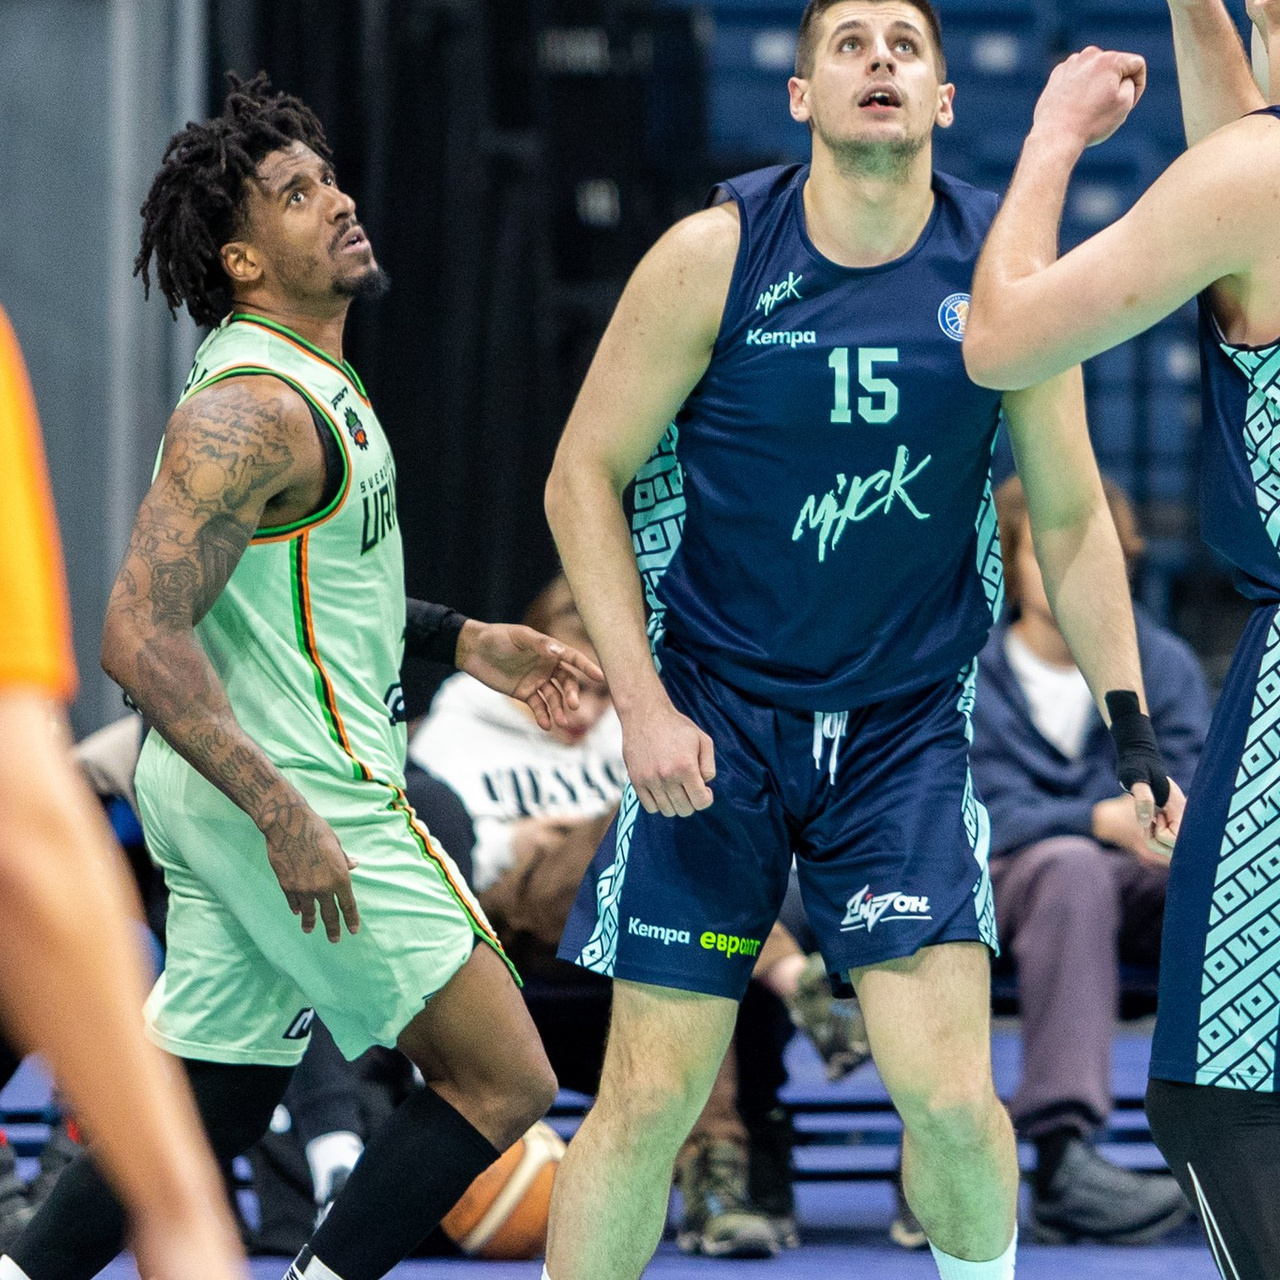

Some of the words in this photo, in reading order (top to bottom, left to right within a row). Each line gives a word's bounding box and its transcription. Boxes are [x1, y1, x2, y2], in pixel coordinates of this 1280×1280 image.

[746, 328, 816, 348] Kempa
[828, 347, 899, 423] 15
[628, 917, 690, 945] Kempa
